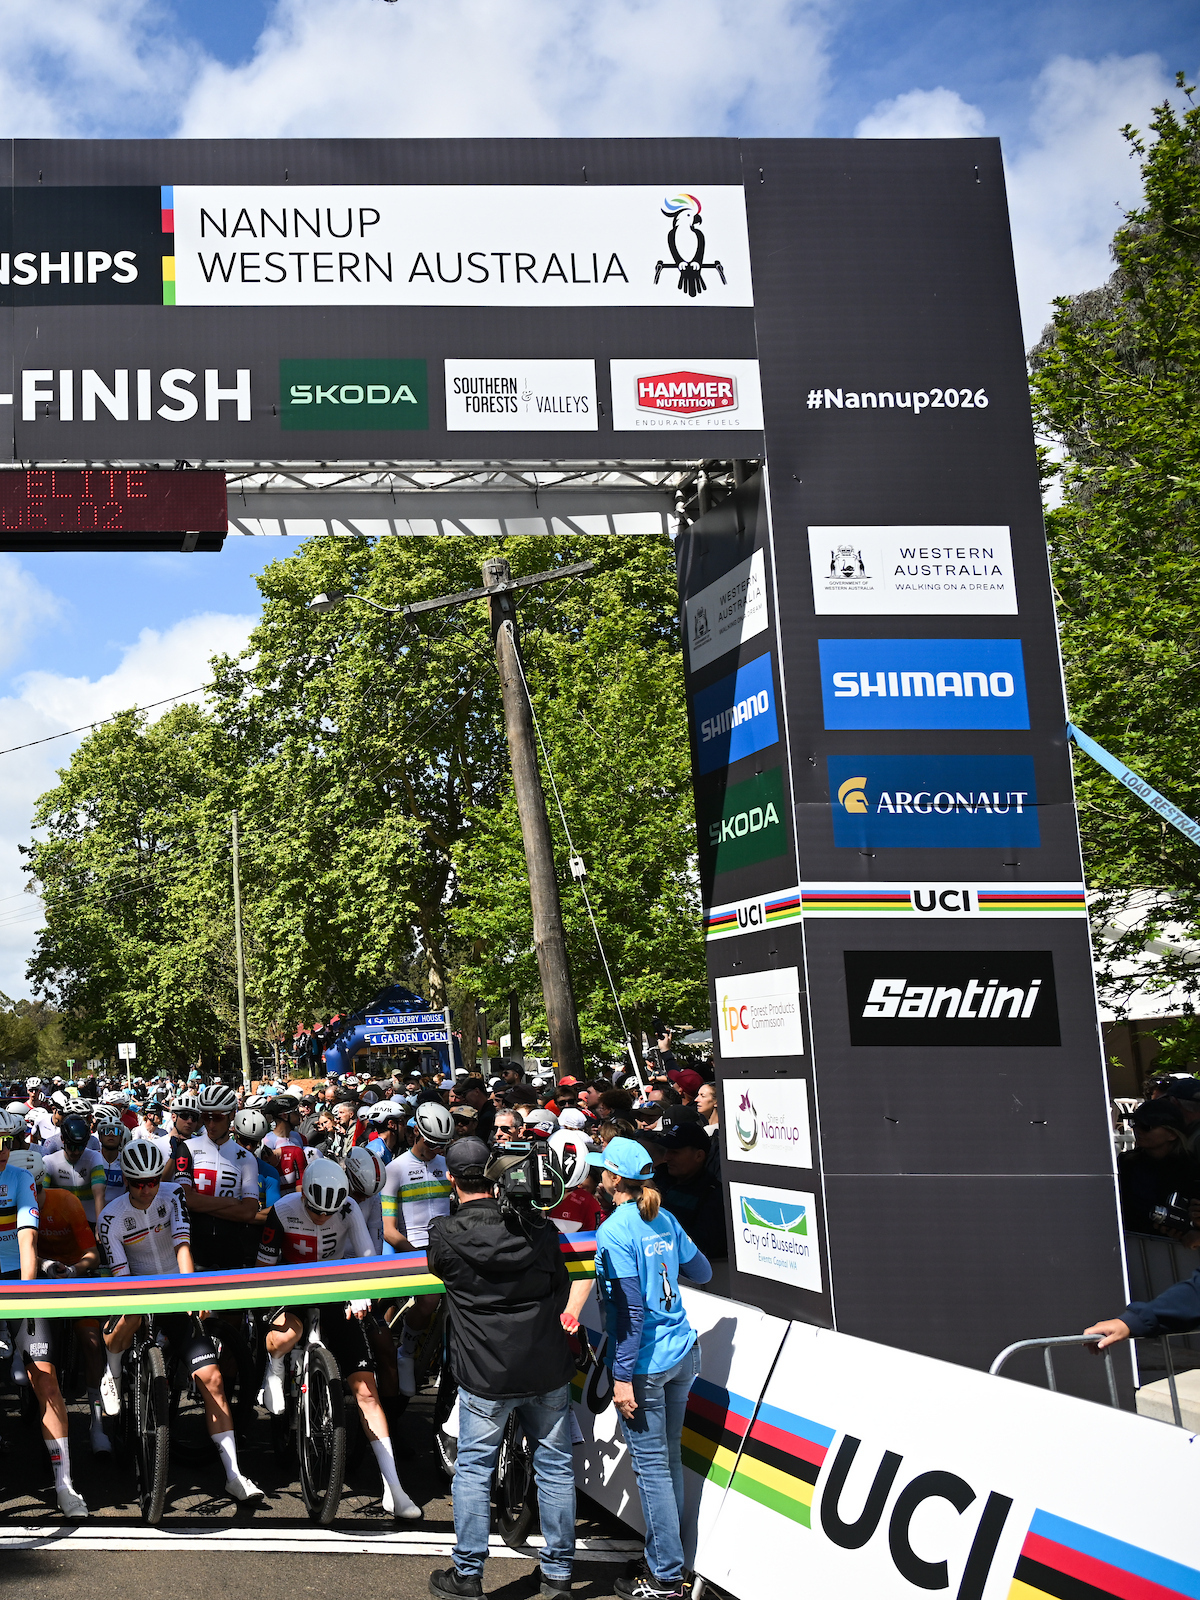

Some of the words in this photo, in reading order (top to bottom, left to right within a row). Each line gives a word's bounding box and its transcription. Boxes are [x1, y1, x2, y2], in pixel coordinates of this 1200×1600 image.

[200, 207, 381, 239] NANNUP
[198, 252, 393, 284] WESTERN
[408, 252, 629, 285] AUSTRALIA
[453, 377, 518, 395] SOUTHERN
[638, 382, 733, 398] HAMMER
[465, 396, 518, 413] FORESTS
[535, 396, 589, 414] VALLEYS
[656, 399, 716, 408] NUTRITION
[806, 387, 990, 415] #Nannup2026
[26, 470, 147, 498] ELITE
[900, 547, 994, 559] WESTERN
[894, 564, 1003, 576] AUSTRALIA
[719, 573, 758, 606] WESTERN
[718, 587, 762, 623] AUSTRALIA
[832, 670, 1015, 698] SHIMANO
[701, 689, 769, 743] SHIMANO
[1120, 772, 1151, 798] LOAD
[876, 790, 1029, 815] ARGONAUT
[913, 889, 971, 912] UCI
[737, 903, 763, 929] UCI
[750, 1005, 768, 1017] Forest
[768, 1002, 795, 1015] Products
[861, 978, 1043, 1019] Santini
[387, 1015, 420, 1024] HOLBERRY
[421, 1013, 442, 1022] HOUSE
[722, 994, 750, 1042] fpc
[751, 1017, 785, 1030] Commission
[381, 1033, 418, 1043] GARDEN
[422, 1032, 446, 1041] OPEN
[761, 1121, 800, 1145] Nannup
[34, 1170, 45, 1181] OC
[321, 1232, 338, 1259] SUI
[644, 1240, 674, 1257] CREW
[743, 1227, 760, 1251] City
[761, 1231, 769, 1248] of
[771, 1232, 810, 1258] Busselton
[758, 1252, 772, 1263] Events
[773, 1255, 789, 1269] Capital
[789, 1260, 798, 1270] WA
[29, 1342, 49, 1350] BELGIAN
[29, 1348, 48, 1356] CYCLING
[820, 1435, 1014, 1600] UCI
